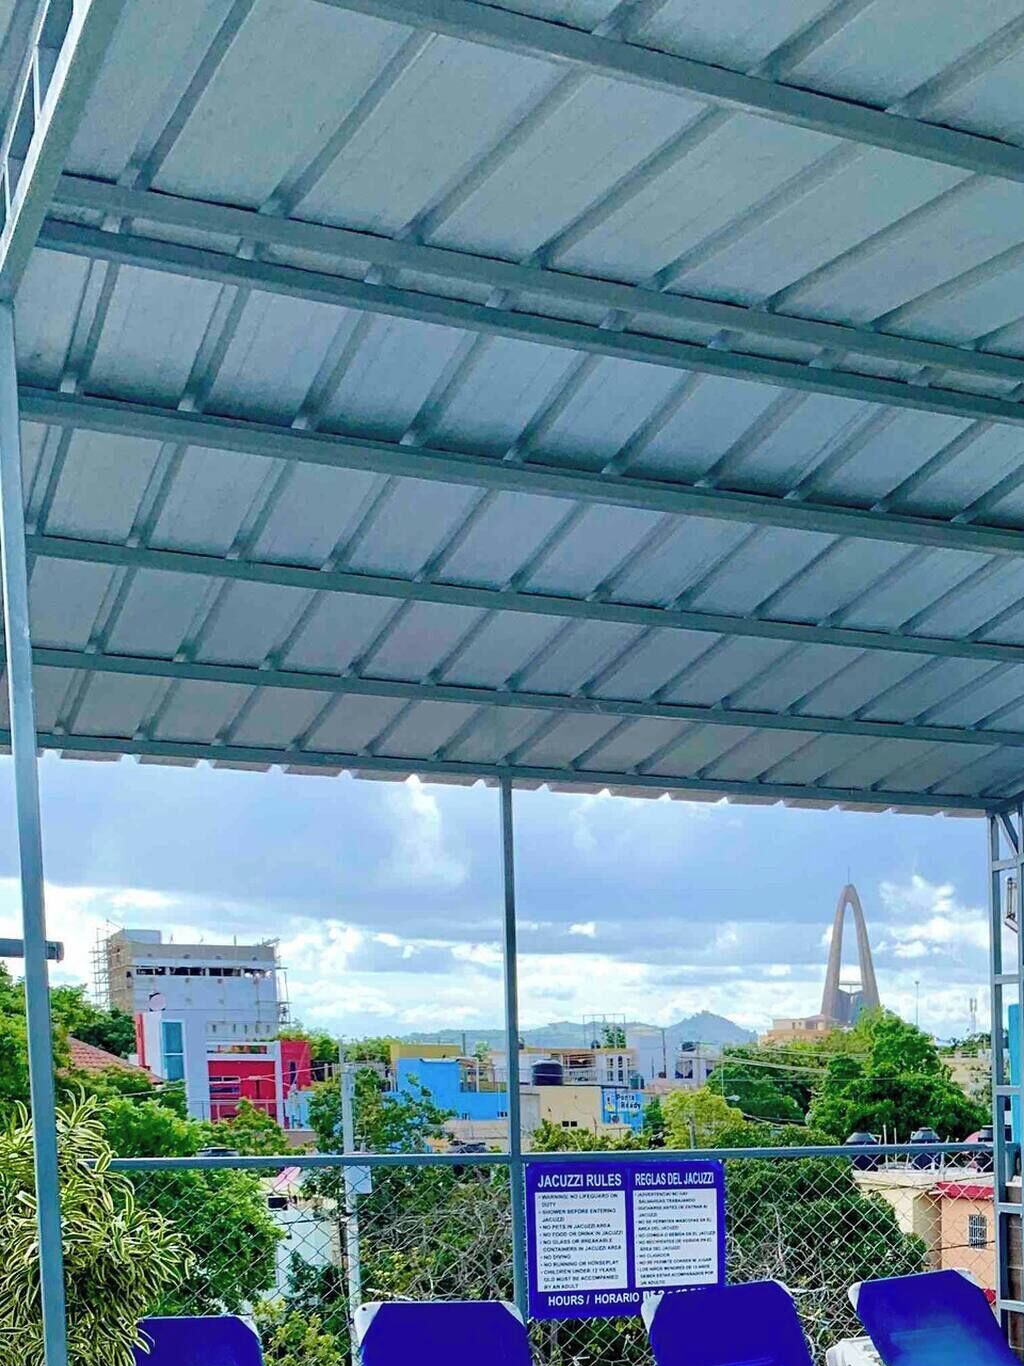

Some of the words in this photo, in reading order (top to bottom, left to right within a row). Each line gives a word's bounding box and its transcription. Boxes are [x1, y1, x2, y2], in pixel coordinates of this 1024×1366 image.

[537, 1174, 584, 1188] JACUZZI
[586, 1173, 622, 1187] RULES
[634, 1173, 666, 1186] REGLAS
[667, 1173, 683, 1185] DEL
[683, 1172, 715, 1185] JACUZZI
[548, 1295, 585, 1306] HOURS
[594, 1292, 640, 1305] HORARIO
